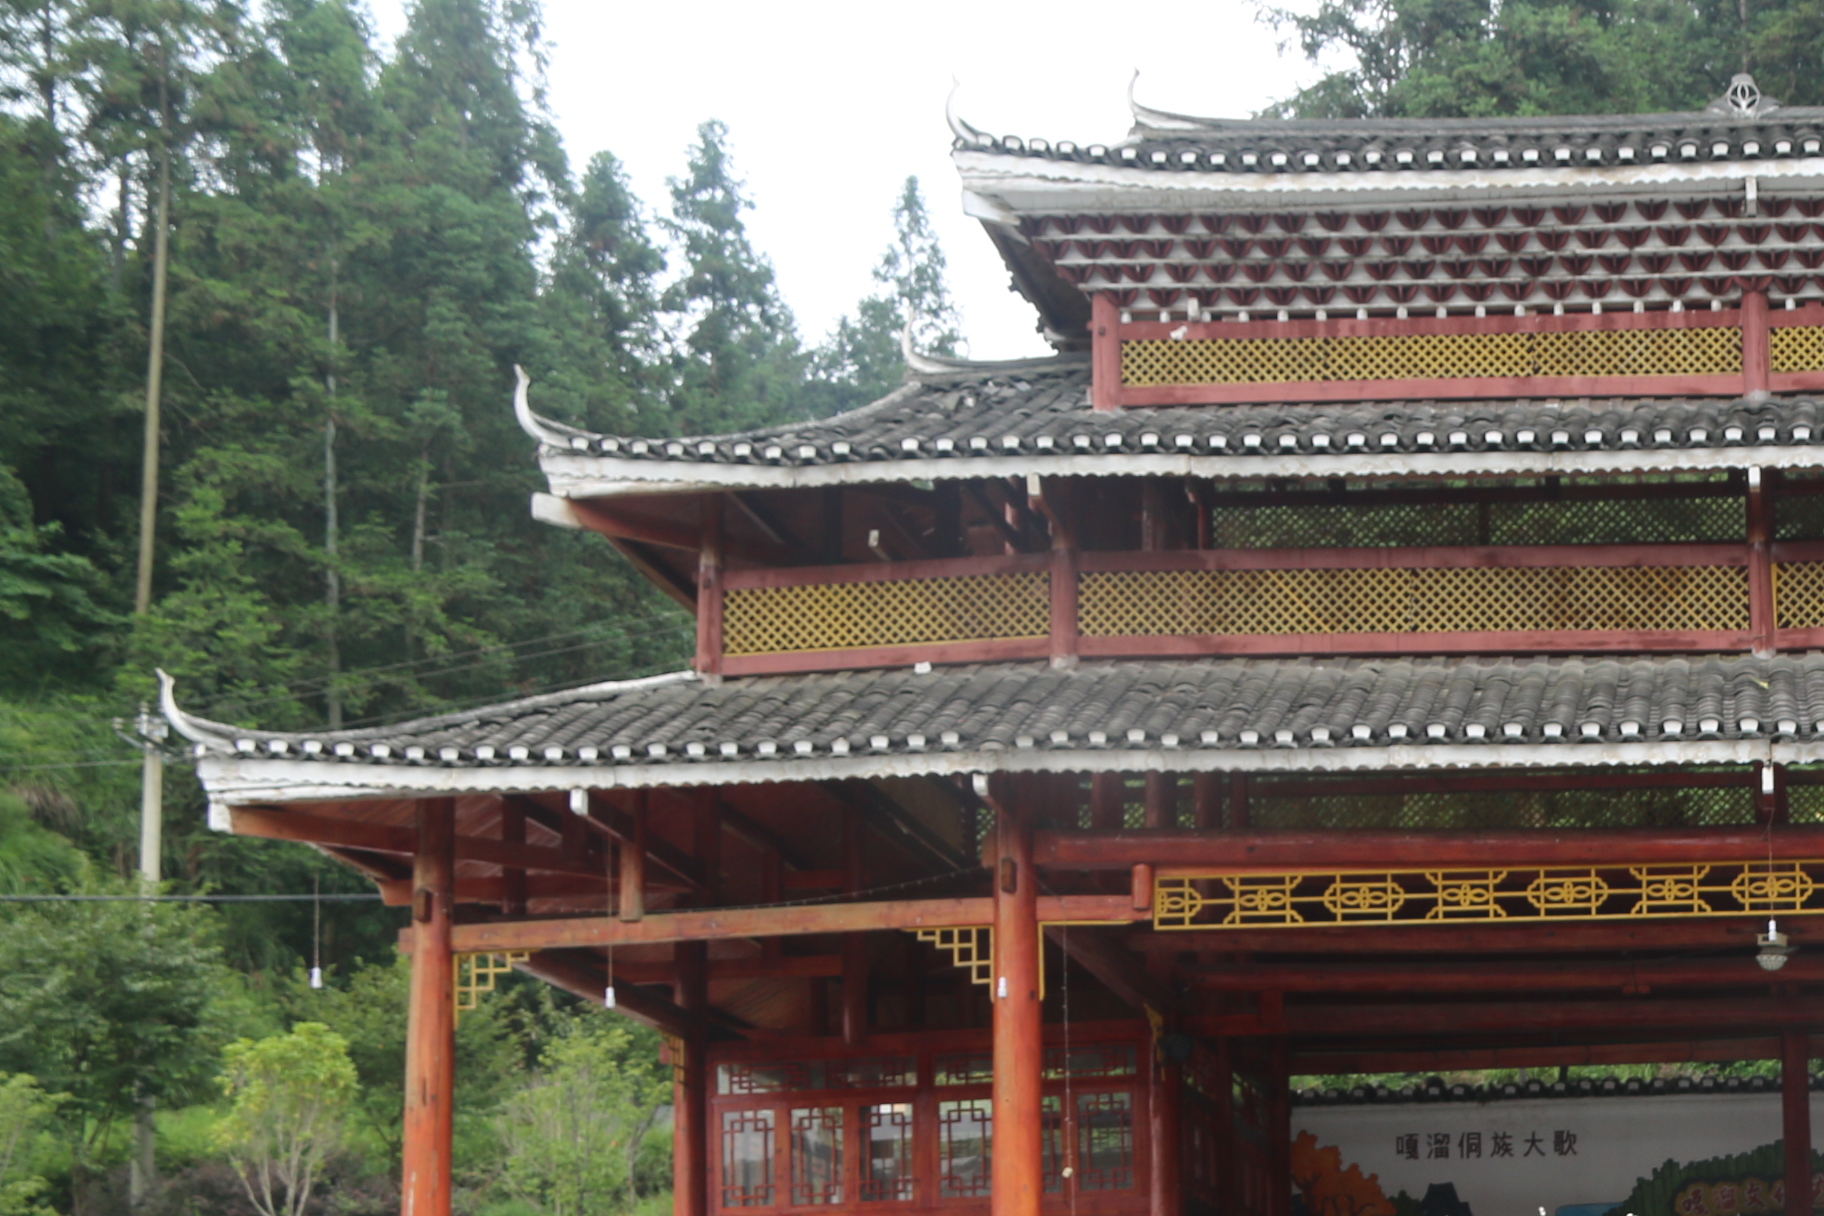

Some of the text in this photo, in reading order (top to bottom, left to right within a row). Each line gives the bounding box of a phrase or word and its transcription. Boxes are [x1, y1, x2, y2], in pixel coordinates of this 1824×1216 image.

[1395, 1130, 1578, 1160] 嘎溜侗族大歌
